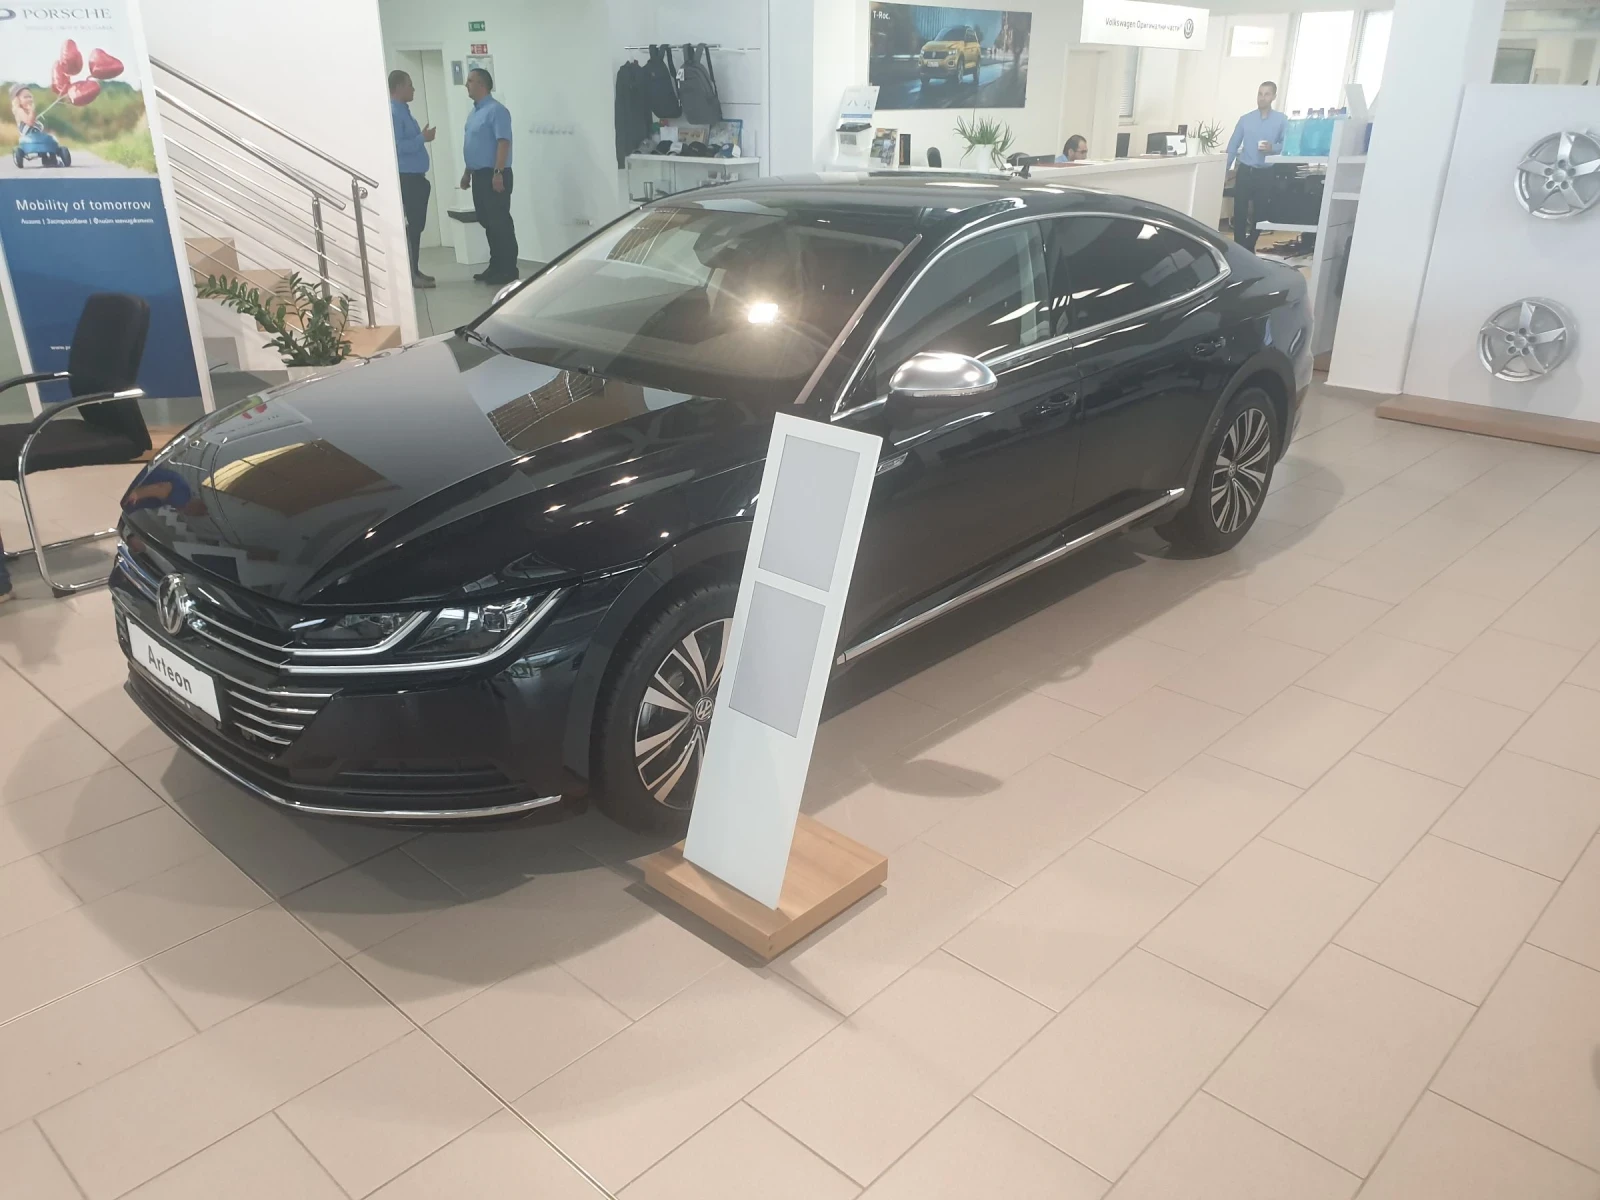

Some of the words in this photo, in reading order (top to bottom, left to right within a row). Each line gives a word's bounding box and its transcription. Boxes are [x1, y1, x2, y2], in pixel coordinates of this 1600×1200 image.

[22, 8, 112, 20] PORSCHE
[1105, 17, 1136, 30] Volkswagen
[16, 199, 69, 213] Mobility
[73, 199, 86, 210] of
[90, 200, 151, 211] tomorrow
[148, 644, 193, 695] Arteon
